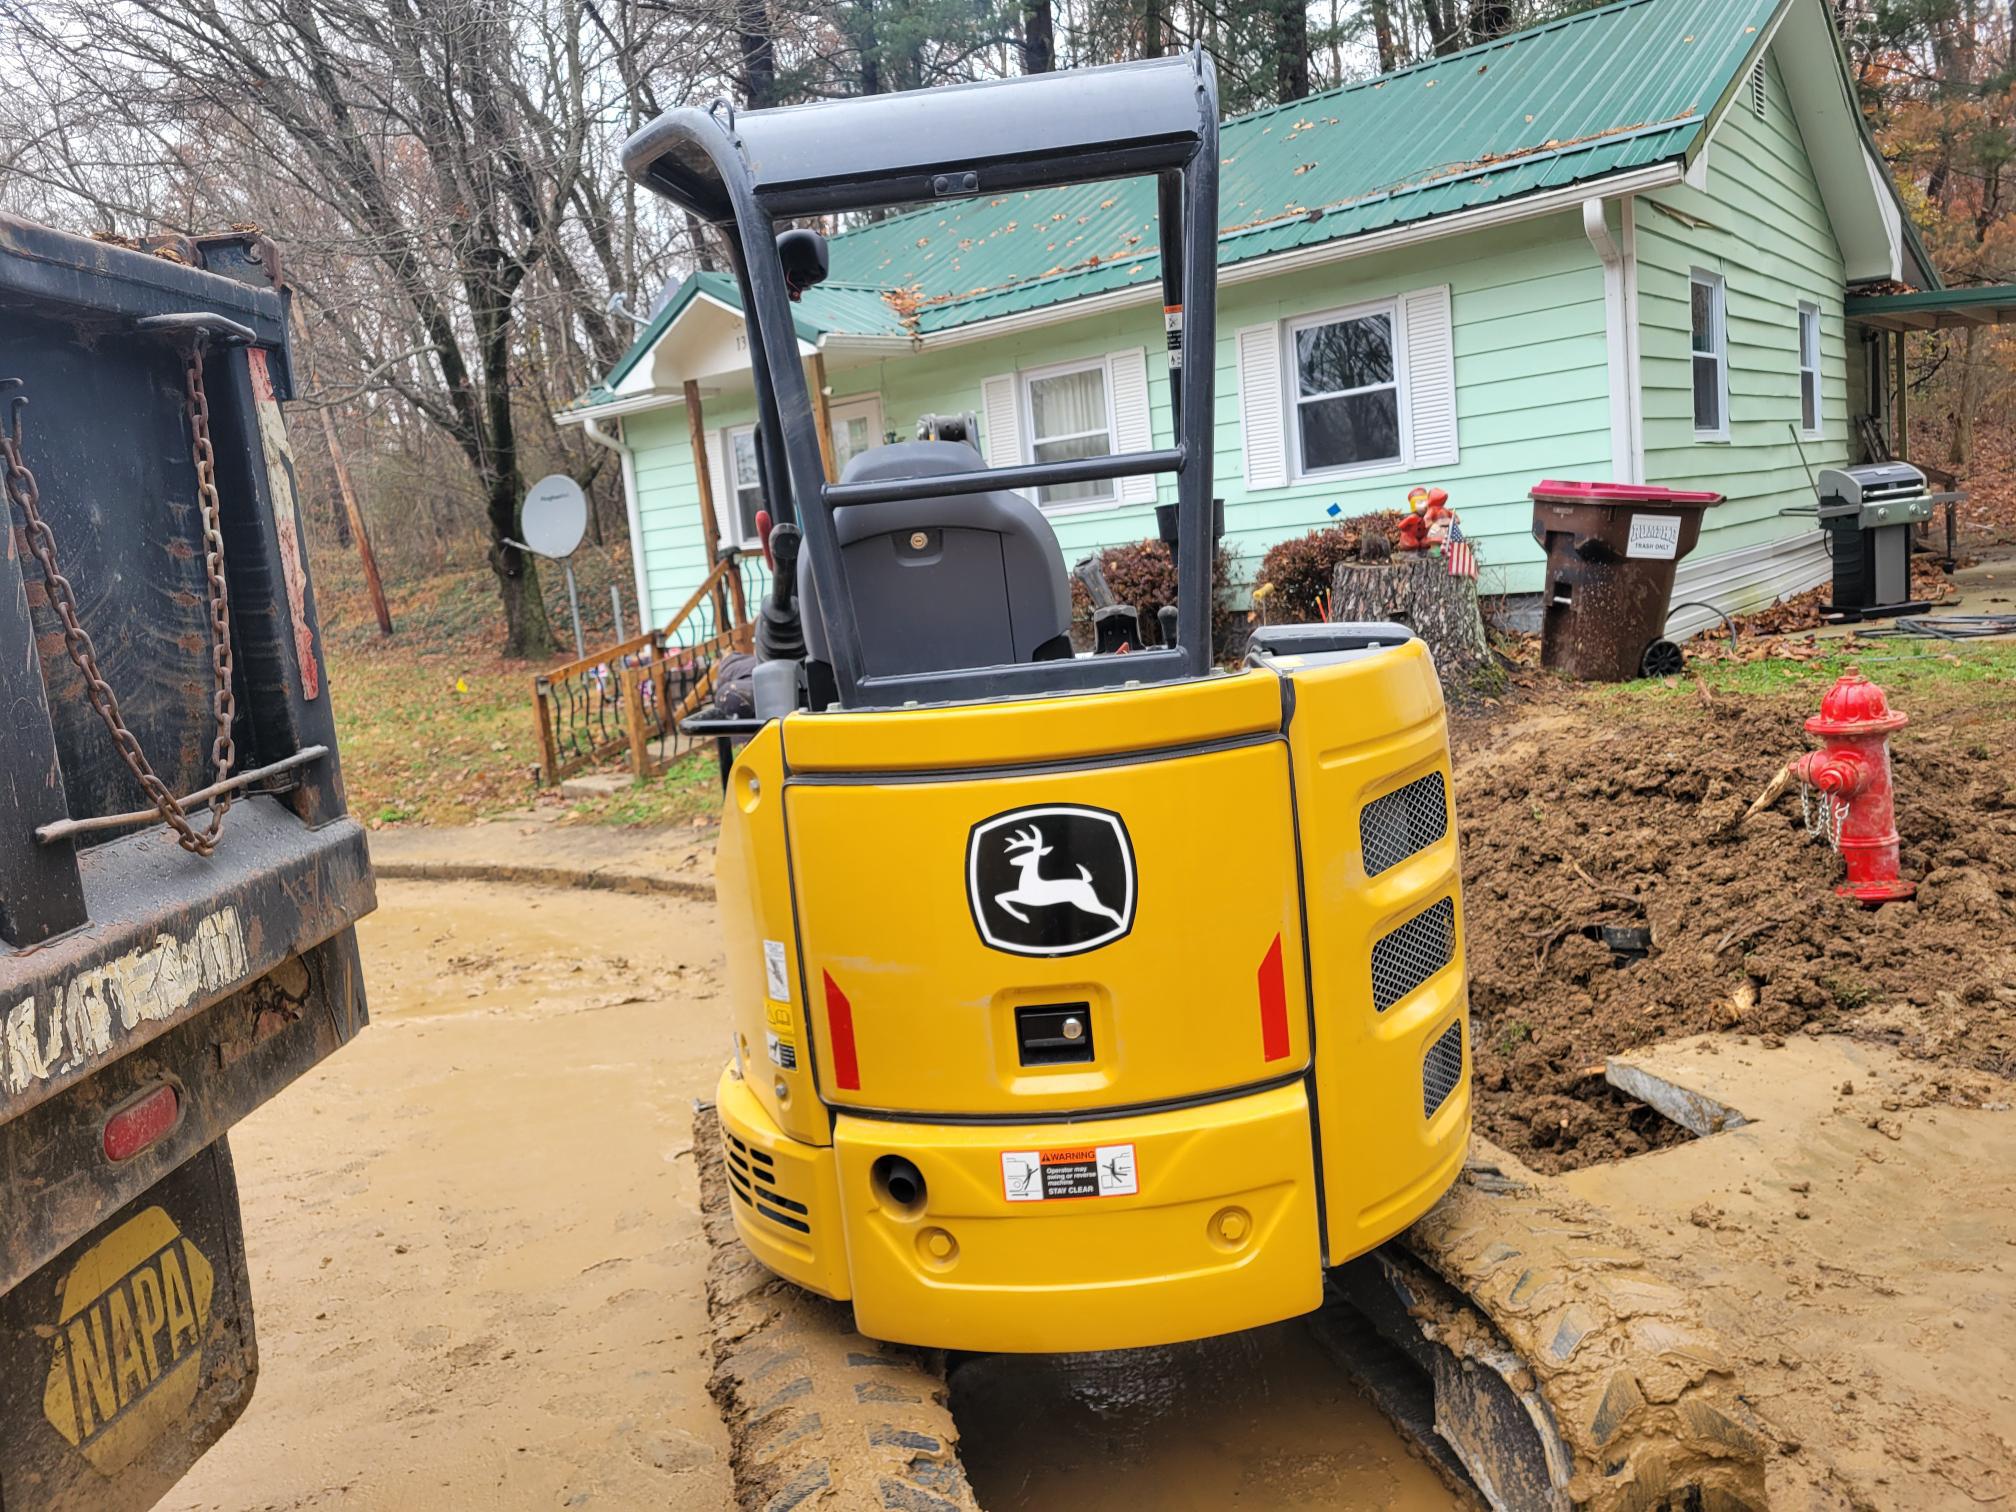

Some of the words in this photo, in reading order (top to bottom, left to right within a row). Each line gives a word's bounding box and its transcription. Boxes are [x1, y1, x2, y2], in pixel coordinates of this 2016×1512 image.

[1635, 542, 1654, 550] TRASH
[1655, 543, 1669, 551] ONLY
[1051, 1151, 1096, 1161] WARNING
[1046, 1167, 1073, 1175] Operator
[1048, 1187, 1067, 1195] STAY
[1068, 1185, 1095, 1194] CLEAR
[67, 1247, 200, 1438] NAPA
